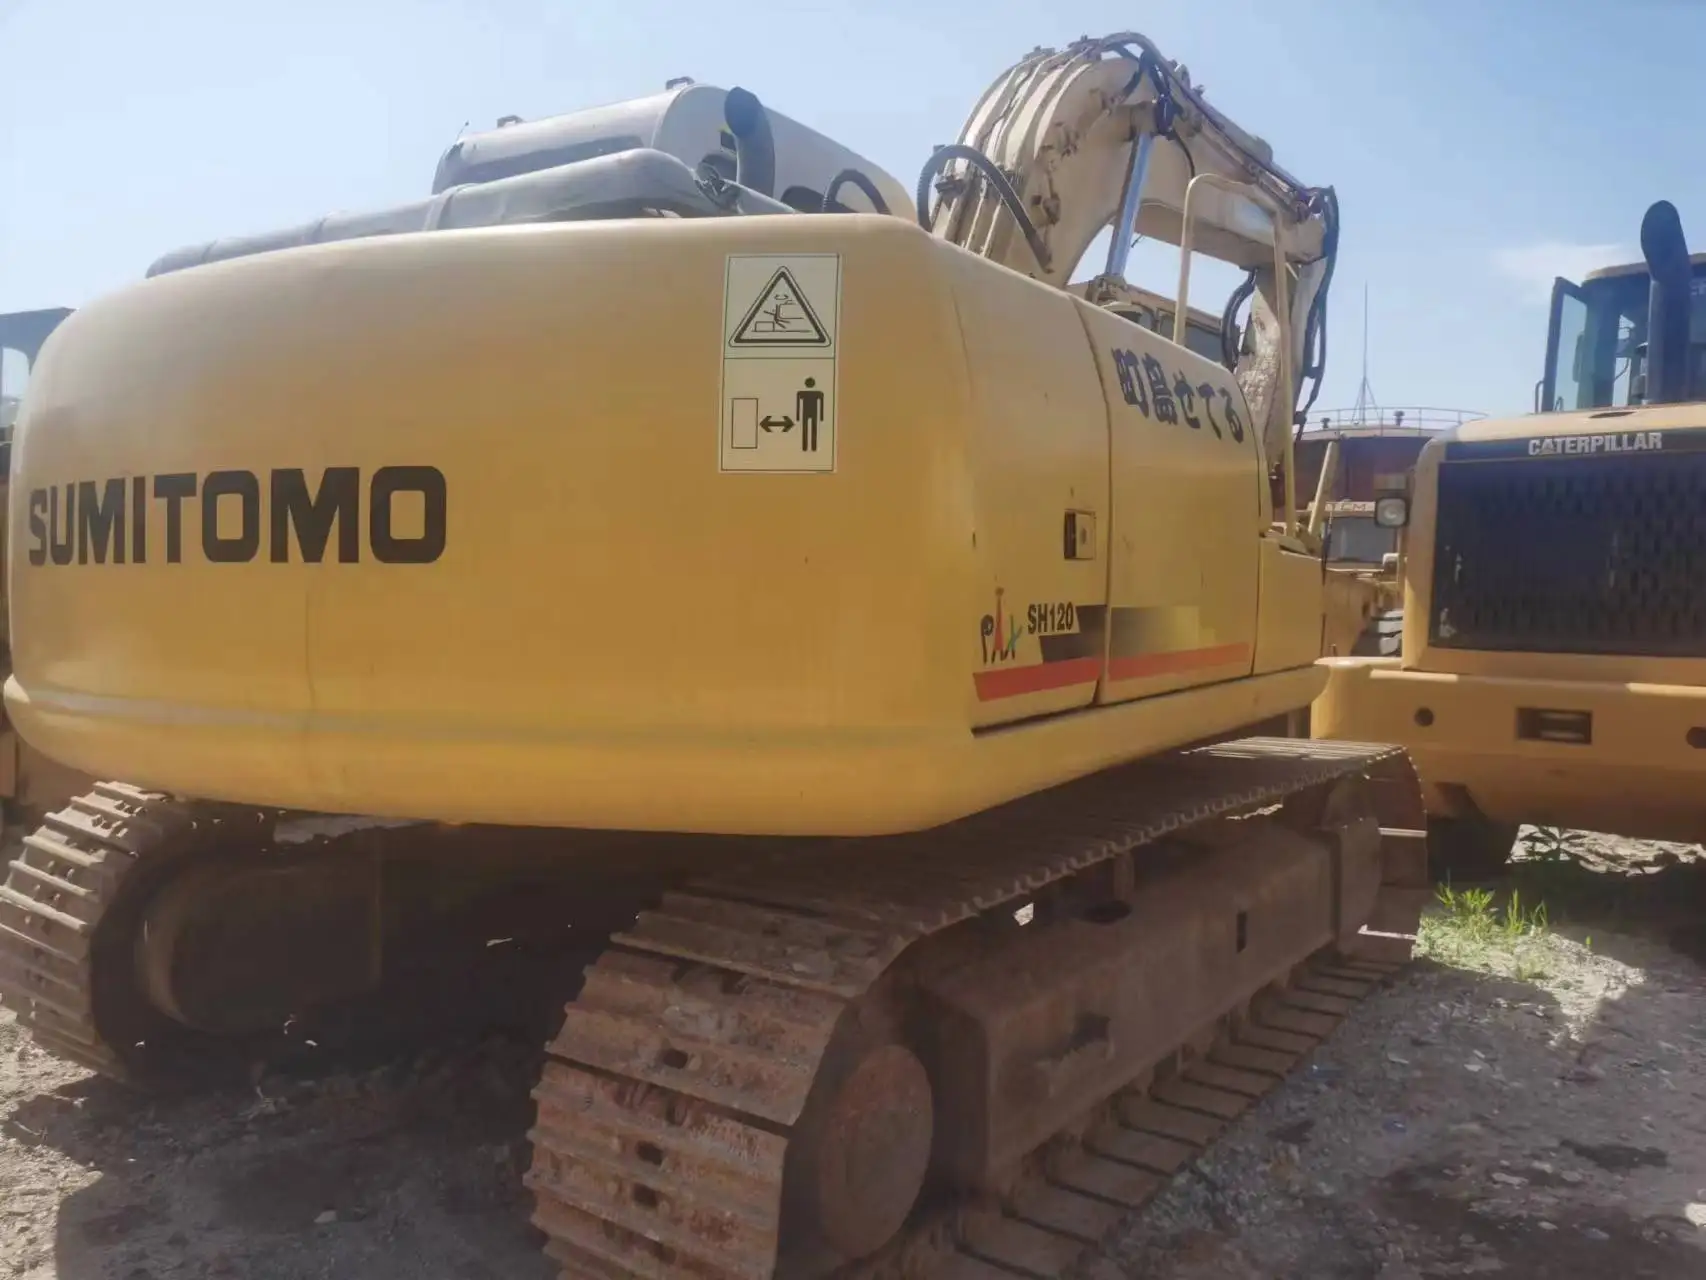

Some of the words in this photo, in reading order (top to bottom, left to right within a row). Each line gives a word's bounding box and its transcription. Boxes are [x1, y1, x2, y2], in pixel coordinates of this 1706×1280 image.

[1528, 432, 1663, 456] CATERPILLAR
[29, 465, 447, 565] SUMITOMO
[1027, 601, 1074, 634] SH120
